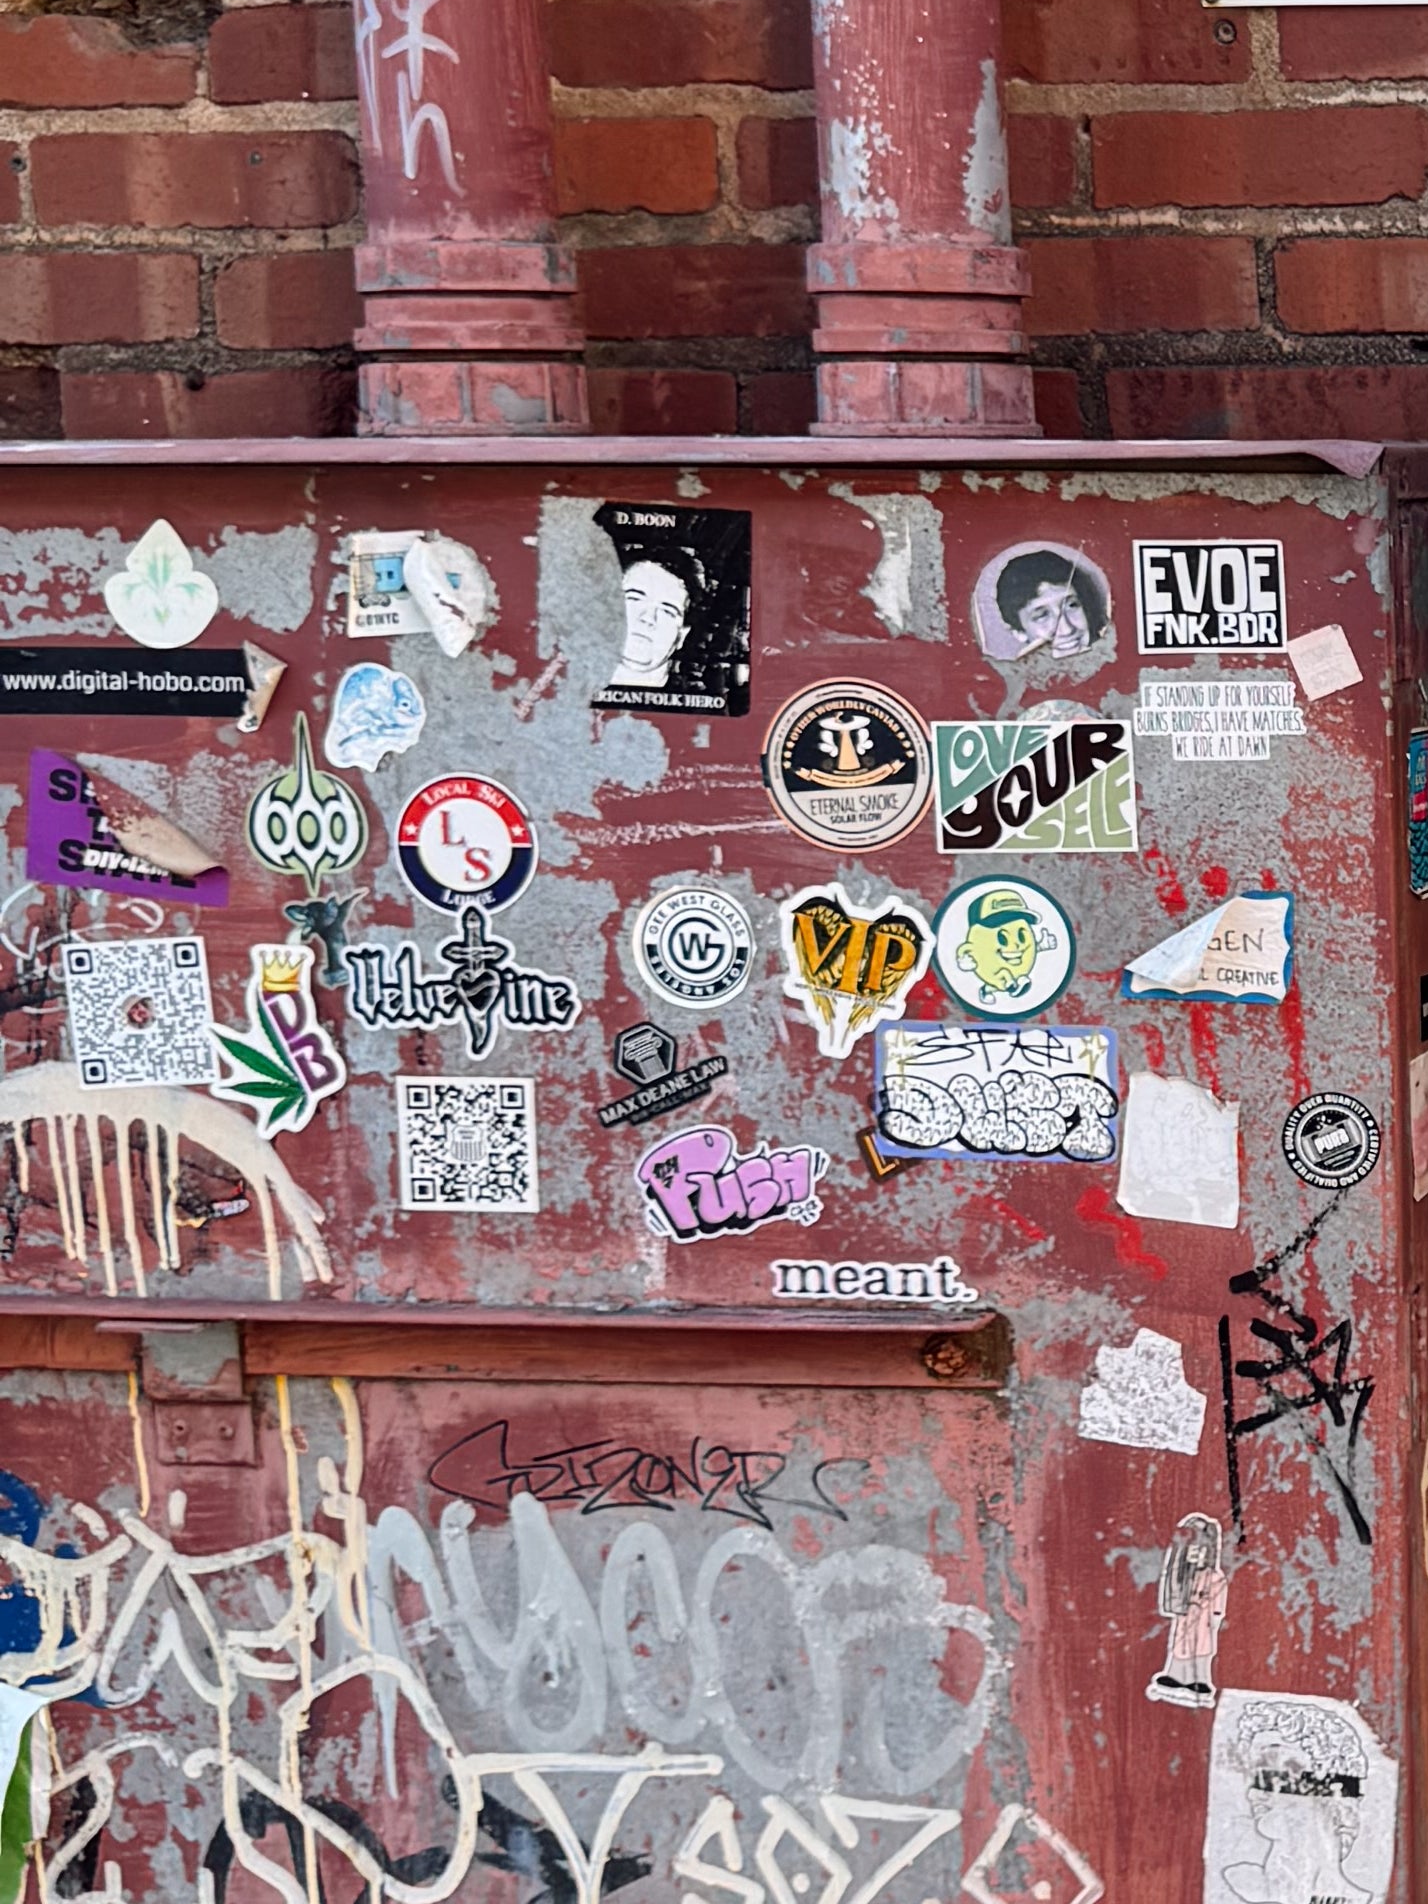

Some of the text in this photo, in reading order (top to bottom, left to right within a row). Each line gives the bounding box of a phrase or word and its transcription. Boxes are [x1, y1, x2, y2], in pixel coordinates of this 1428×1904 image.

[616, 511, 676, 528] D. BOON
[1141, 546, 1278, 614] EVOE
[1145, 612, 1279, 646] FNK.BDR
[2, 669, 248, 696] www.digital-hobo.com
[1144, 685, 1293, 707] IF STANDING UP FOR YOURSELF
[645, 691, 683, 707] FOLK
[685, 694, 726, 709] HERO
[1136, 710, 1169, 732] BURNS
[1221, 710, 1250, 731] HAVE
[1175, 736, 1267, 758] WE RIDE AT DAWN
[938, 724, 1052, 815] LOVE
[421, 782, 507, 809] LOCAL SKI
[942, 722, 1128, 850] YOUR
[810, 792, 900, 817] ETERNAL SMOKE
[1000, 753, 1133, 849] SELF
[830, 814, 857, 825] SOLAR
[667, 894, 706, 914] WEST
[710, 899, 746, 938] GLASS
[793, 912, 918, 996] VIP
[1216, 966, 1280, 988] CREATIVE
[599, 1096, 639, 1125] MAX
[638, 1073, 694, 1106] DEANE
[691, 1056, 725, 1083] LAW
[778, 1261, 975, 1300] meant.
